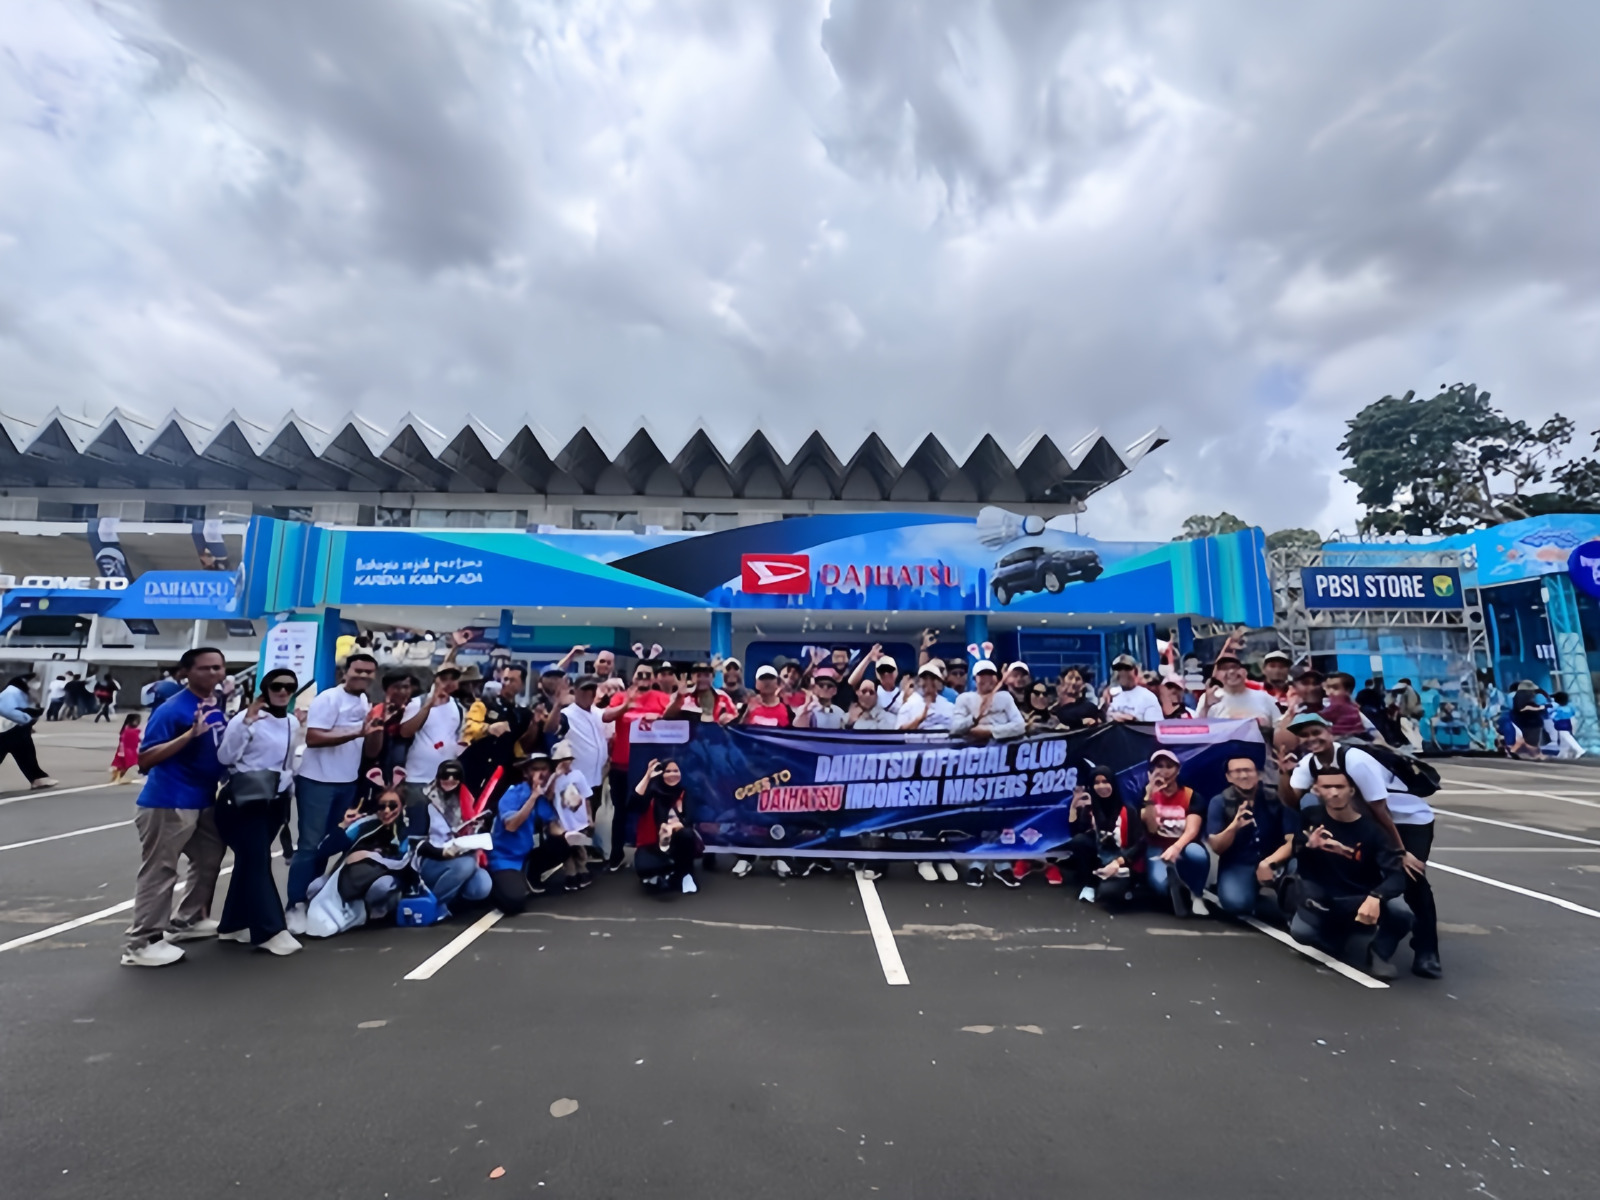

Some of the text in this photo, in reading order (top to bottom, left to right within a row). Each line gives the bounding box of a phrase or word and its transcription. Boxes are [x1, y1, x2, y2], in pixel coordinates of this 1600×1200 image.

[95, 577, 129, 590] TO
[820, 564, 960, 588] DAIHATSU
[1315, 574, 1426, 598] PBSI STORE
[144, 581, 229, 596] DAIHATSU
[814, 739, 1068, 783] DAIHATSU OFFICIAL CLUB
[757, 767, 1078, 813] DAIHATSU INDONESIA MASTERS 2026
